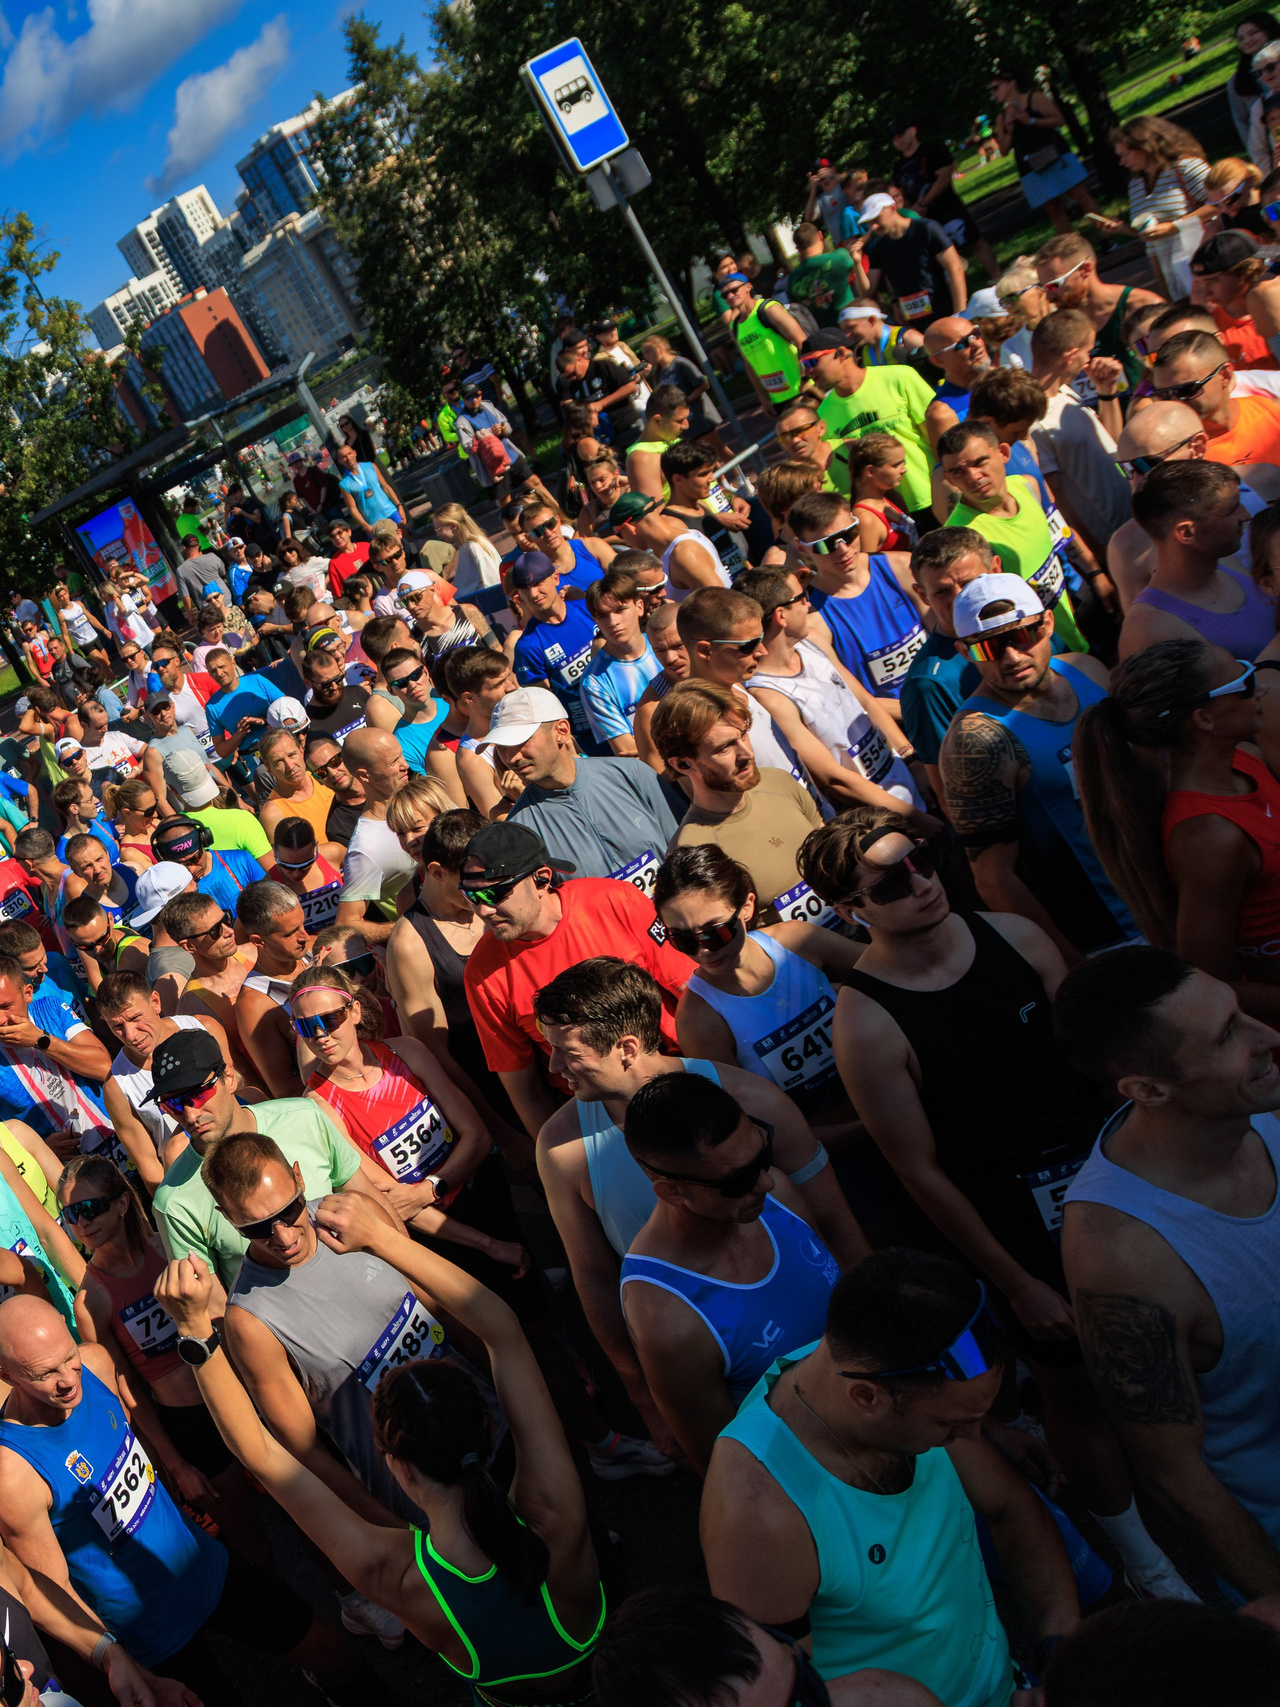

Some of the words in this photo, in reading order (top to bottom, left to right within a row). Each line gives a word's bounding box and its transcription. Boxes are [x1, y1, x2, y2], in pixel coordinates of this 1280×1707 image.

[1, 897, 24, 918] 6310
[302, 893, 341, 921] 7210
[389, 1113, 442, 1165] 5364
[135, 1308, 172, 1339] 72
[101, 1453, 146, 1524] 7562
